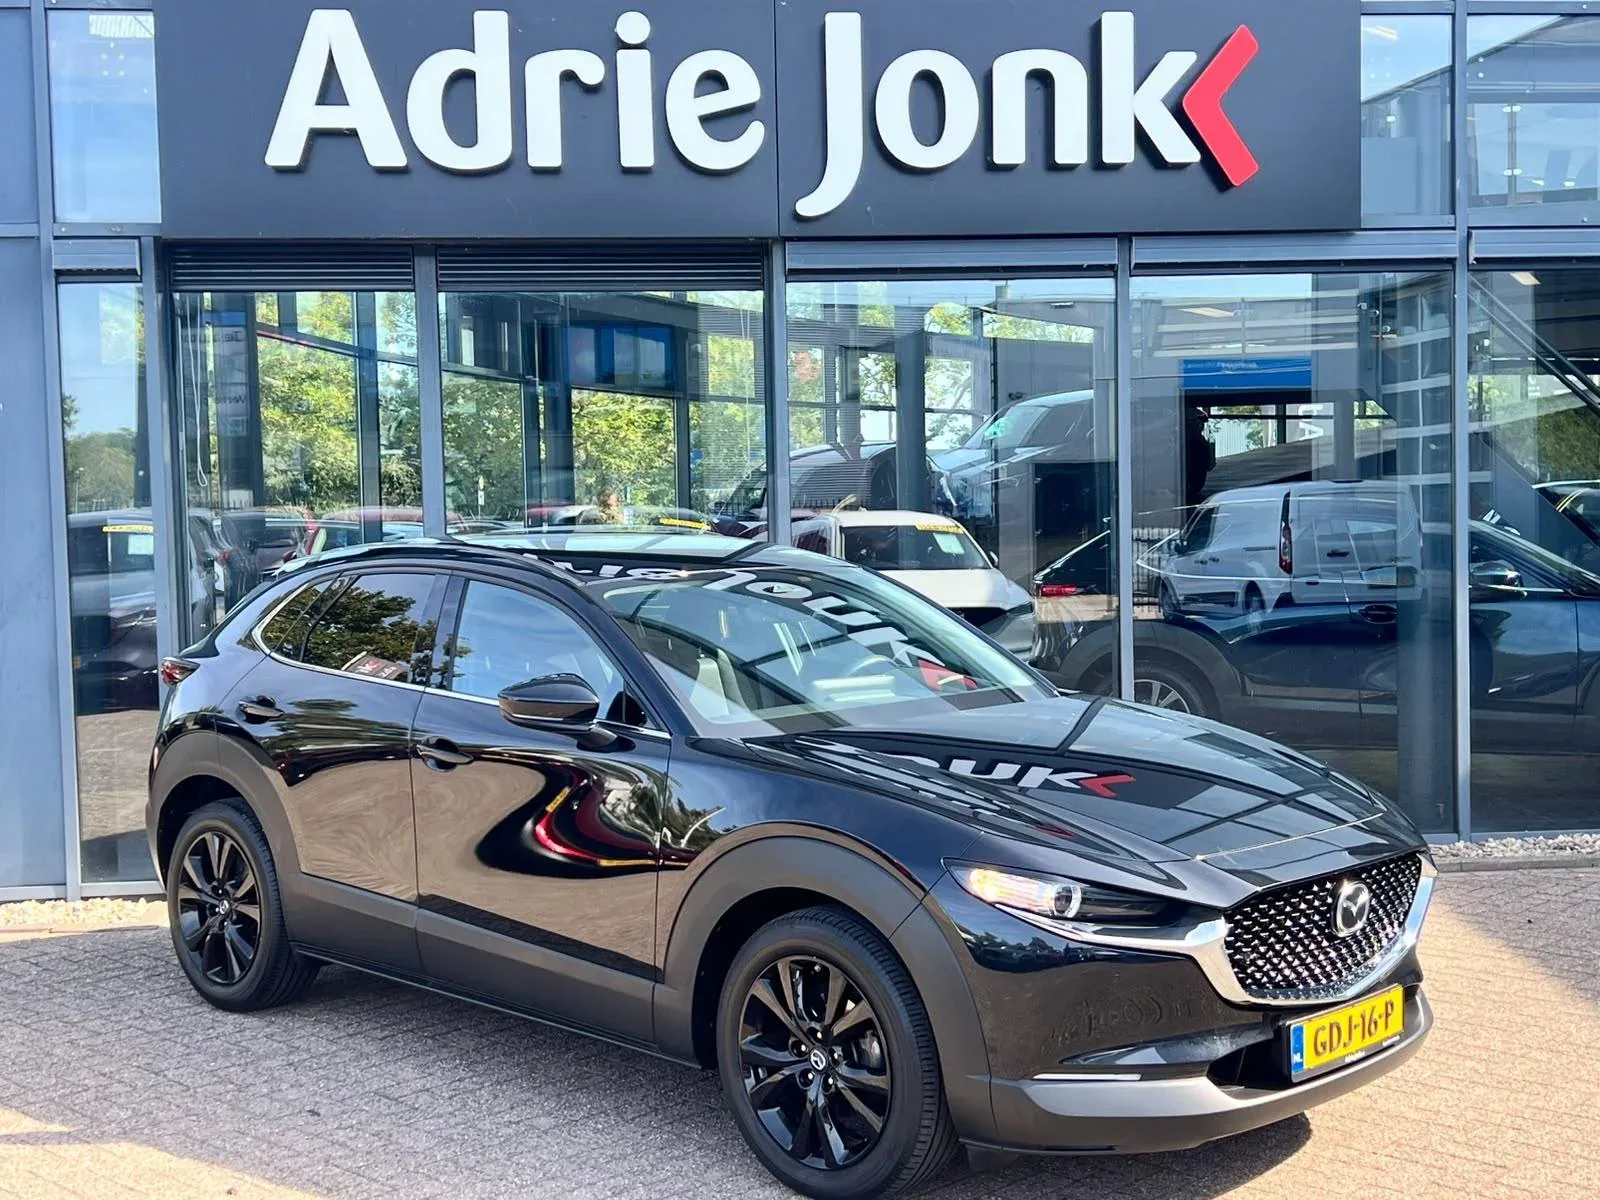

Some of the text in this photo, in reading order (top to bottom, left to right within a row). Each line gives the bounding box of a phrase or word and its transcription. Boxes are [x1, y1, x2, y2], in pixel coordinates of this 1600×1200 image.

[264, 10, 1201, 217] Adrie Jonk
[1313, 1000, 1394, 1057] GDJ-16-P
